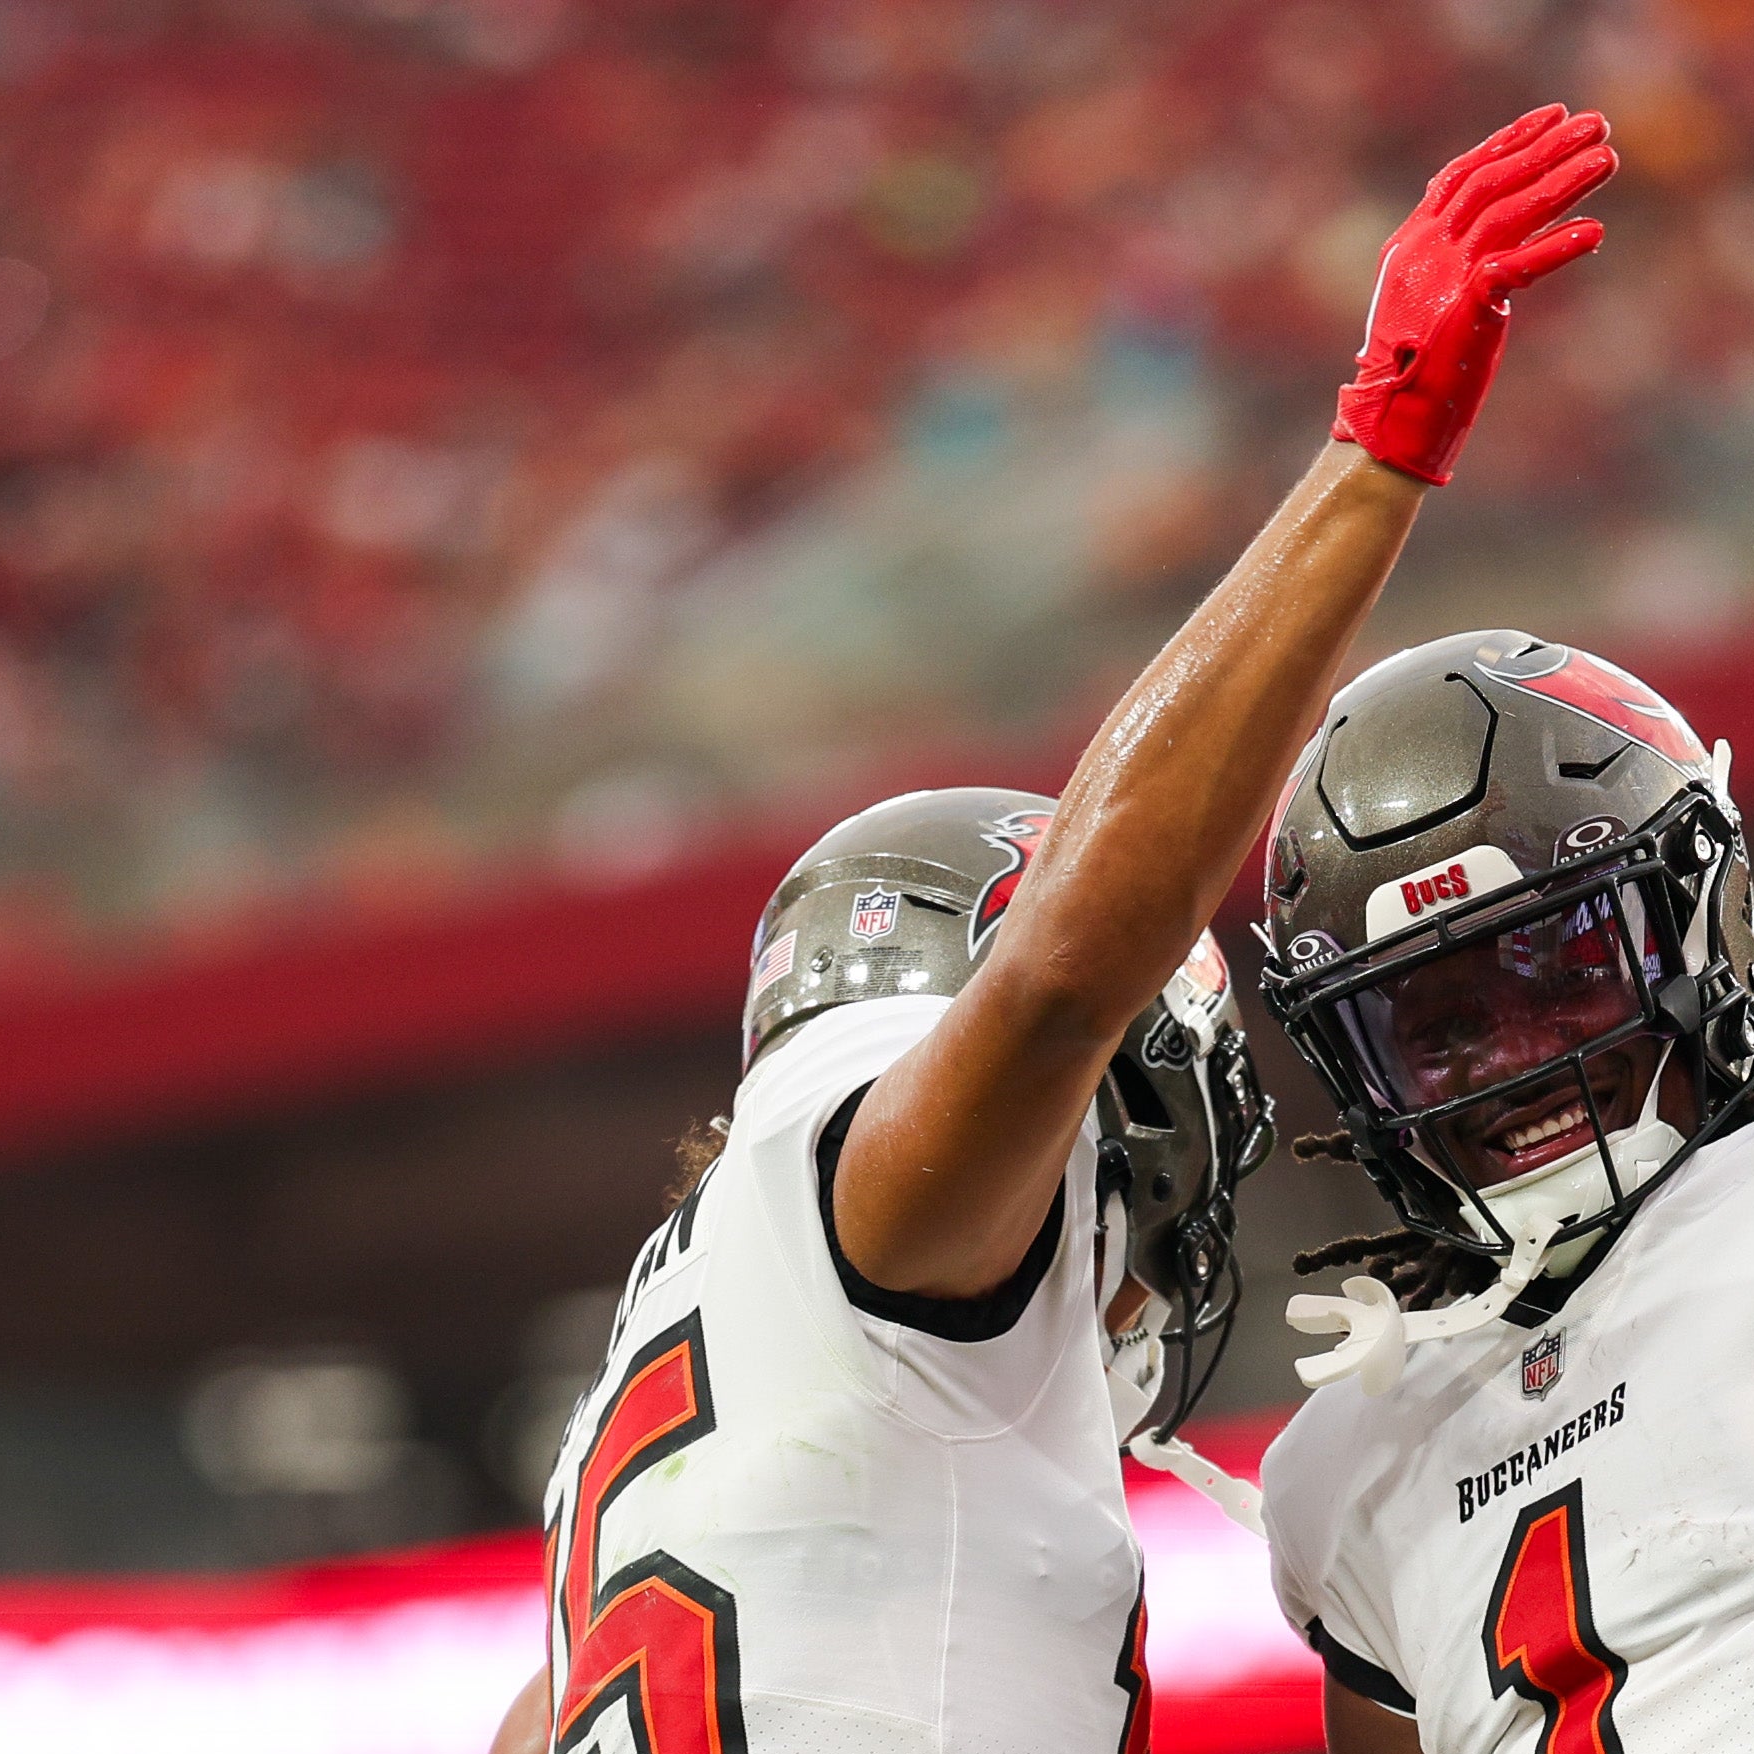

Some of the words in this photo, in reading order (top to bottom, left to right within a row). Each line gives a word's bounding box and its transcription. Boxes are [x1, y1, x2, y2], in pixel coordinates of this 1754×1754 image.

[856, 911, 890, 932] NFL
[1525, 1356, 1557, 1389] NFL
[1455, 1381, 1627, 1525] BUCCANEERS
